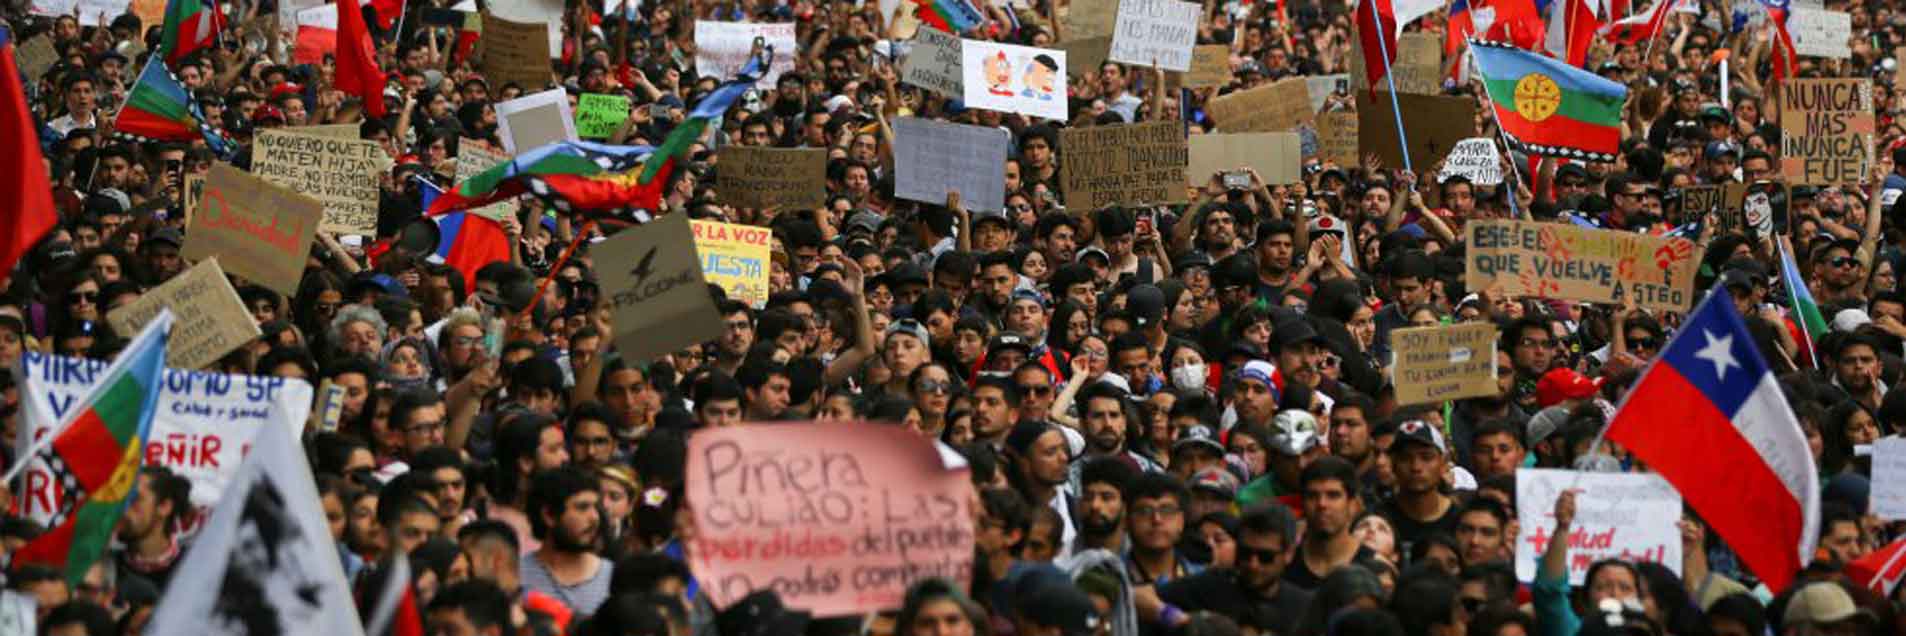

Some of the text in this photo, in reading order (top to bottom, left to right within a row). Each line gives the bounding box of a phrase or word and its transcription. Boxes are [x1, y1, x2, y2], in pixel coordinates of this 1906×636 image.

[1786, 80, 1861, 111] NUNCA
[266, 148, 321, 167] MATEN
[276, 135, 324, 153] QUIERO
[326, 139, 359, 155] QUE
[360, 143, 379, 159] TE
[1804, 157, 1867, 184] FUE!
[707, 224, 729, 241] LA
[733, 227, 769, 246] VOZ
[699, 251, 762, 279] UESTA
[1475, 253, 1521, 277] QUE
[1533, 255, 1612, 287] VUELVE
[1611, 279, 1625, 300] A
[704, 439, 869, 496] Piñera
[1567, 526, 1617, 549] alud
